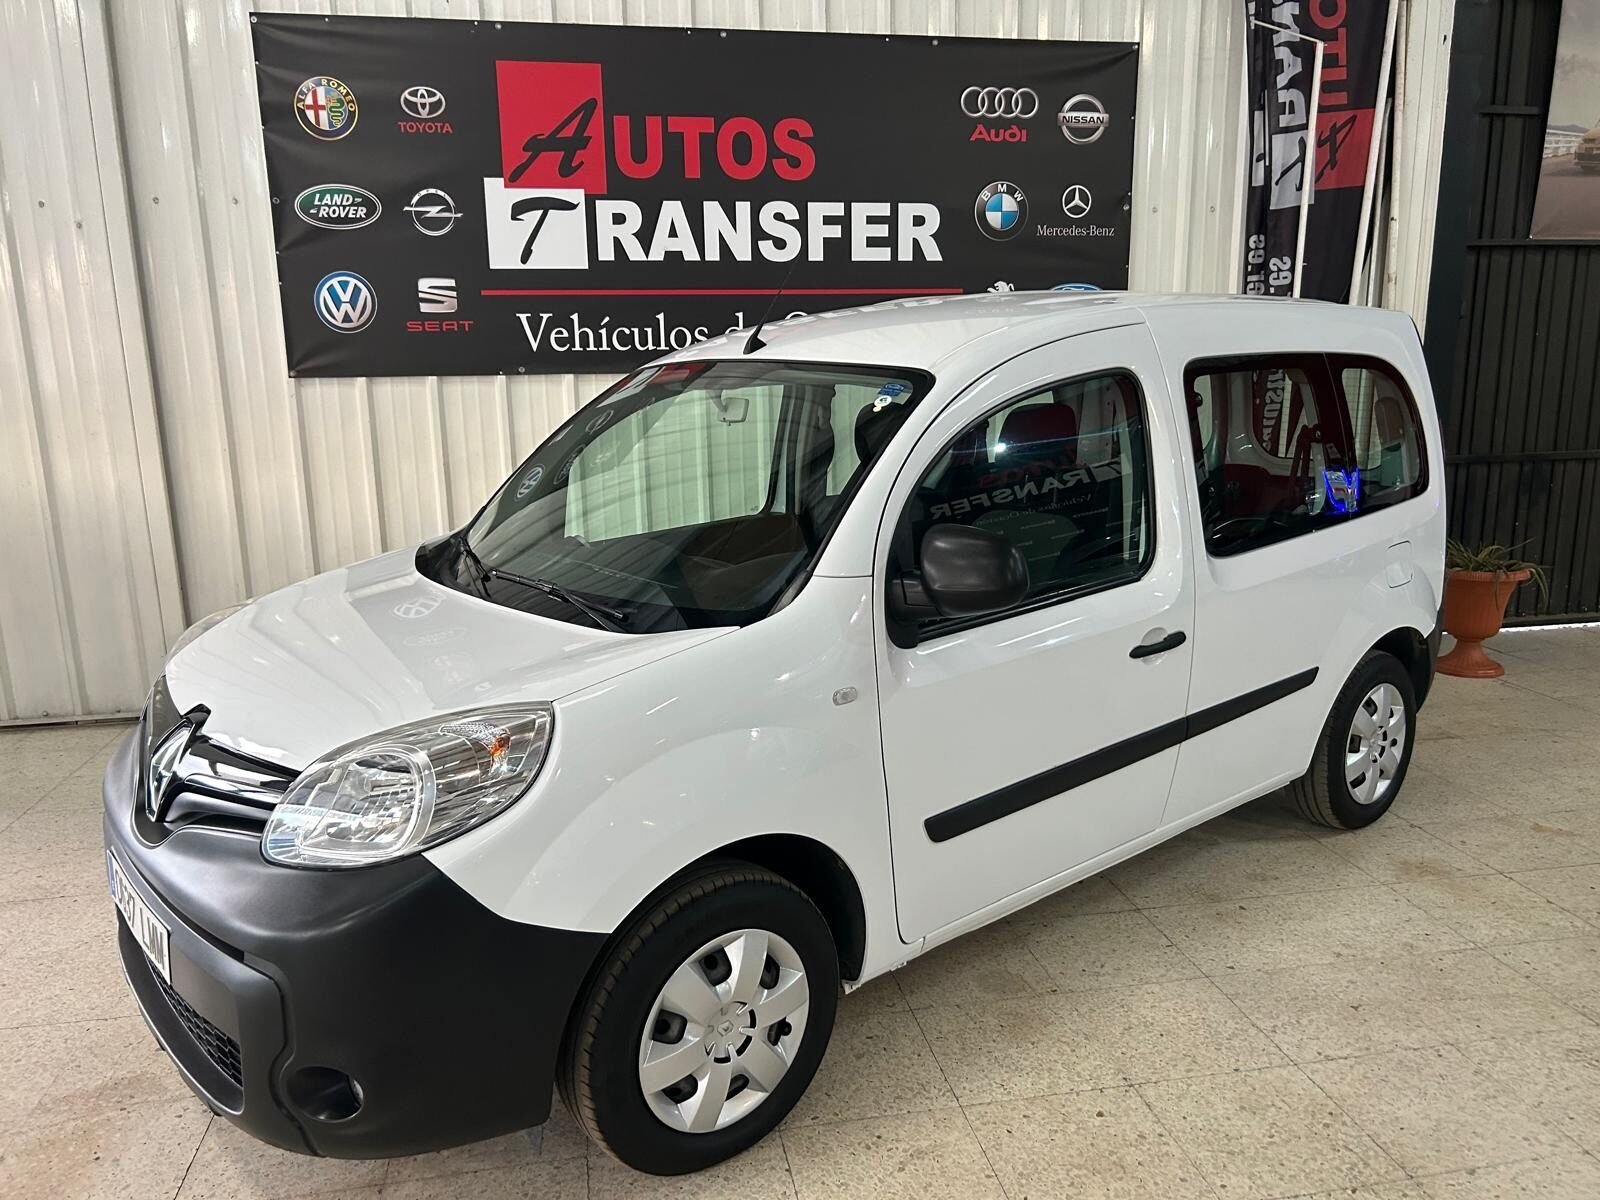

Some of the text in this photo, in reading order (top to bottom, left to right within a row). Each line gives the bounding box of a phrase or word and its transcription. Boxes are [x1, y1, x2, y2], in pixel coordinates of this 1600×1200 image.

[296, 78, 355, 112] ALFA ROMEO
[1062, 115, 1105, 124] NISSAN
[398, 121, 453, 134] TOYOTA
[970, 124, 1027, 142] Audi
[508, 97, 816, 183] AUTOS
[314, 193, 353, 206] LAND
[981, 183, 1024, 202] BMW
[318, 206, 367, 218] ROVER
[510, 196, 944, 265] TRANSFER
[1037, 225, 1115, 237] Mercedes-Benz
[406, 320, 474, 332] SEAT
[516, 312, 710, 352] Vehículos
